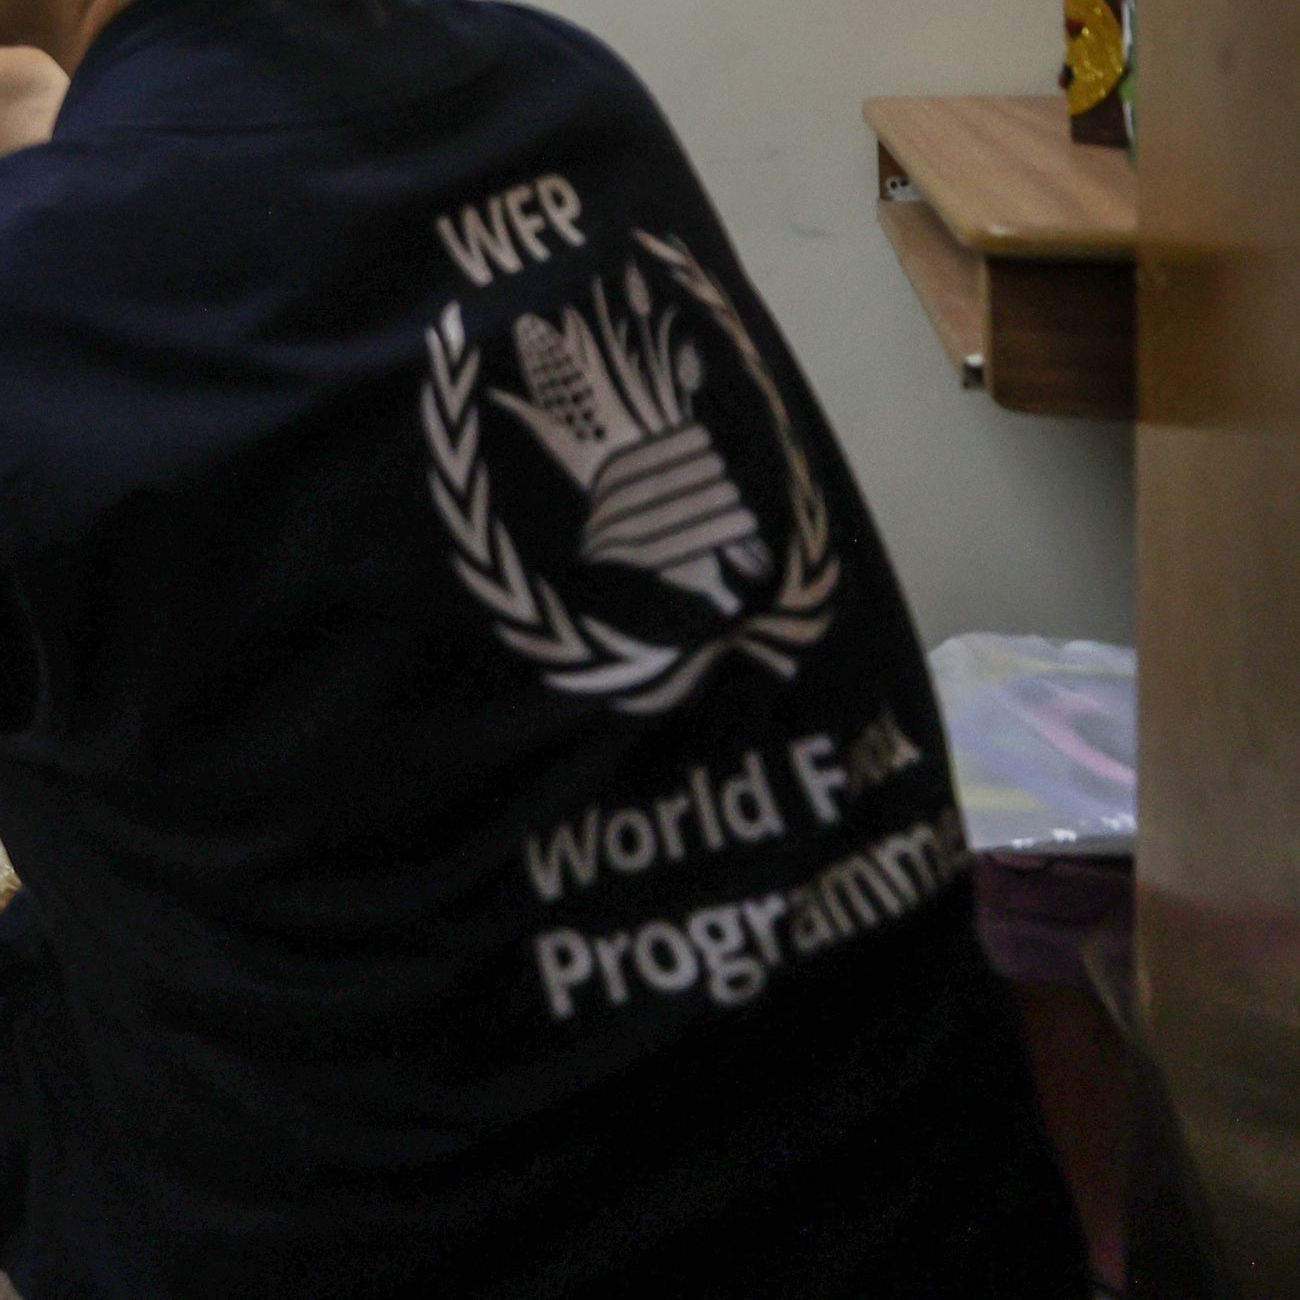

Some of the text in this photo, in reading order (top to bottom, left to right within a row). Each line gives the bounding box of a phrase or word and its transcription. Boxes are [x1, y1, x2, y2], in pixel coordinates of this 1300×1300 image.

[436, 173, 587, 288] WFP
[525, 745, 787, 901] World
[535, 804, 974, 1019] Programm
